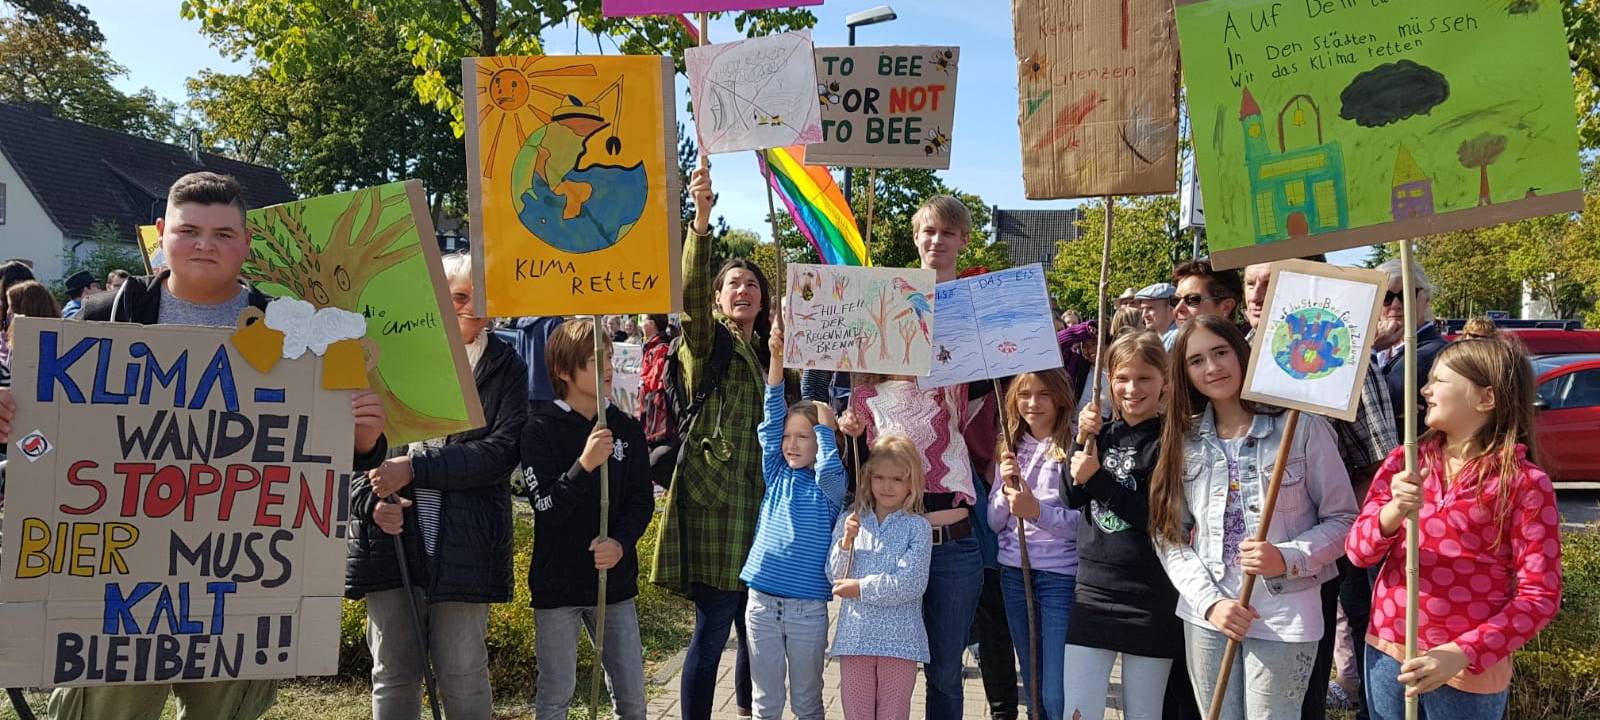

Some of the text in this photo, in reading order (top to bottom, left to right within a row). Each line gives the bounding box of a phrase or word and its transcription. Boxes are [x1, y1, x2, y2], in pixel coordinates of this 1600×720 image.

[1227, 13, 1478, 70] In Den Städten müssen
[822, 55, 923, 76] TO BEE
[1271, 63, 1298, 78] das
[1367, 39, 1423, 57] retten
[1052, 64, 1137, 87] Grenzen
[842, 84, 945, 115] OR NOT
[821, 117, 922, 144] TO BEE
[516, 258, 576, 281] KLIMA
[979, 270, 1034, 289] DAS EIS
[821, 318, 847, 330] DER
[117, 410, 331, 464] WANDEL
[523, 466, 539, 492] SEA
[59, 459, 350, 539] STOPPEN!
[16, 517, 294, 588] BIER MUSS
[102, 581, 237, 635] KALT
